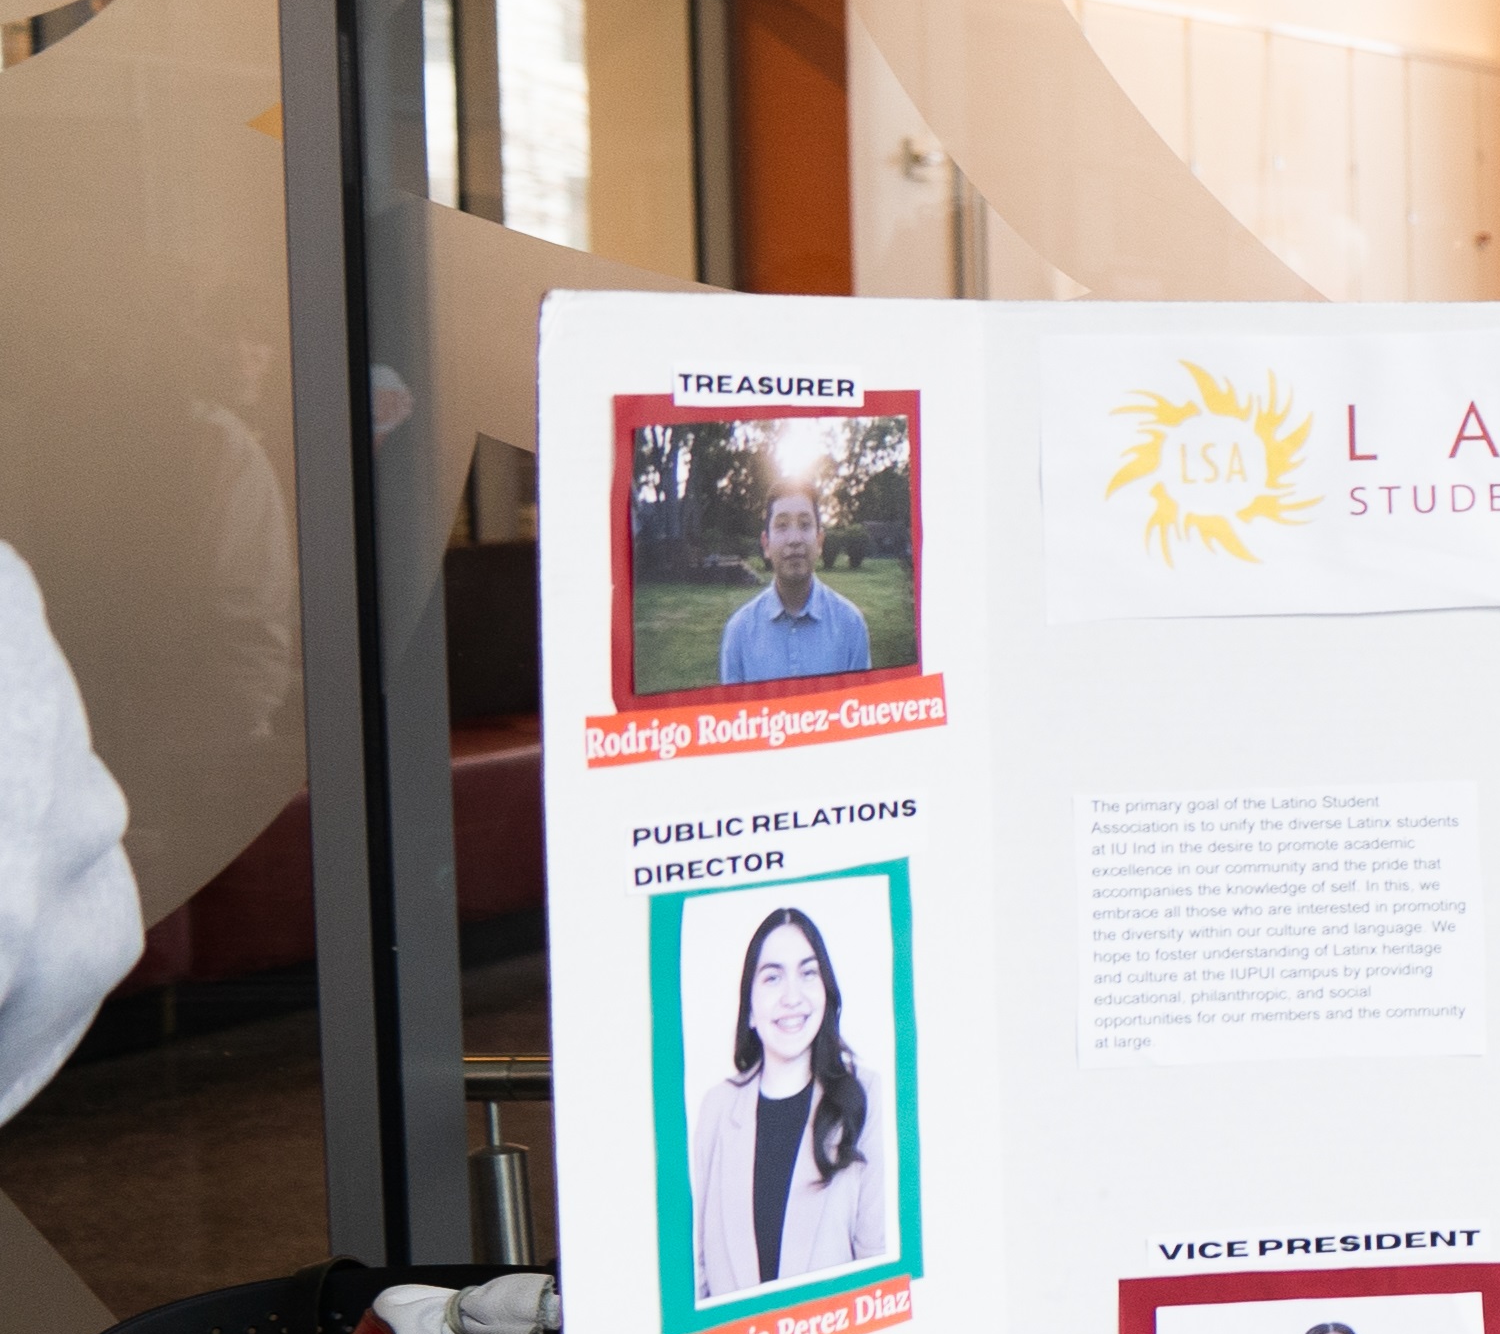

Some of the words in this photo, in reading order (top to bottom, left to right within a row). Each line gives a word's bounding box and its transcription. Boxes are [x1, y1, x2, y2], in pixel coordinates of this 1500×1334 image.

[679, 372, 856, 398] TREASURER
[1180, 441, 1248, 485] LSA
[586, 722, 691, 761] Rodrigo
[699, 692, 946, 749] Rodriguez-Guevera
[1091, 800, 1120, 813] The
[1125, 801, 1182, 815] primary
[1187, 798, 1219, 814] goal
[1224, 797, 1238, 810] of
[1242, 798, 1266, 810] the
[1271, 797, 1317, 810] Latino
[1322, 795, 1379, 809] Student
[632, 817, 744, 848] PUBLIC
[752, 798, 918, 835] RELATIONS
[1091, 821, 1179, 834] Association
[1183, 822, 1196, 832] is
[1200, 820, 1215, 832] to
[1219, 818, 1255, 834] unify
[1260, 819, 1283, 831] the
[1288, 818, 1342, 830] diverse
[1347, 817, 1391, 829] Latinx
[1396, 816, 1459, 828] students
[1091, 844, 1105, 856] at
[1111, 843, 1127, 855] IU
[1133, 842, 1156, 855] Ind
[1161, 844, 1174, 853] in
[1179, 842, 1203, 854] the
[1207, 841, 1253, 853] desire
[1258, 840, 1272, 852] to
[1277, 839, 1339, 854] promote
[1344, 838, 1415, 850] academic
[633, 851, 785, 887] DIRECTOR
[1091, 864, 1173, 878] excellence
[1177, 865, 1191, 874] in
[1195, 865, 1220, 875] our
[1225, 861, 1306, 876] community
[1311, 860, 1339, 872] and
[1344, 859, 1367, 871] the
[1372, 859, 1408, 873] pride
[1413, 858, 1441, 870] that
[1094, 971, 1122, 984] and
[1127, 971, 1178, 983] culture
[1183, 970, 1197, 982] at
[1202, 969, 1225, 981] the
[1230, 966, 1275, 980] IUPUI
[1280, 967, 1339, 980] campus
[1343, 965, 1361, 980] by
[1365, 964, 1433, 979] providing
[1093, 991, 1185, 1006] educational,
[1191, 989, 1290, 1005] philanthropic,
[1296, 987, 1324, 1000] and
[1329, 986, 1371, 999] social
[1094, 1013, 1192, 1029] opportunities
[1197, 1011, 1216, 1024] for
[1221, 1012, 1246, 1023] our
[1250, 1009, 1321, 1022] members
[1325, 1007, 1353, 1020] and
[1358, 1007, 1381, 1019] the
[1385, 1005, 1466, 1019] community
[1095, 1037, 1109, 1049] at
[1114, 1036, 1155, 1051] large.
[1158, 1240, 1248, 1260] VICE
[1258, 1229, 1482, 1257] PRESIDENT
[855, 1288, 911, 1326] Diaz
